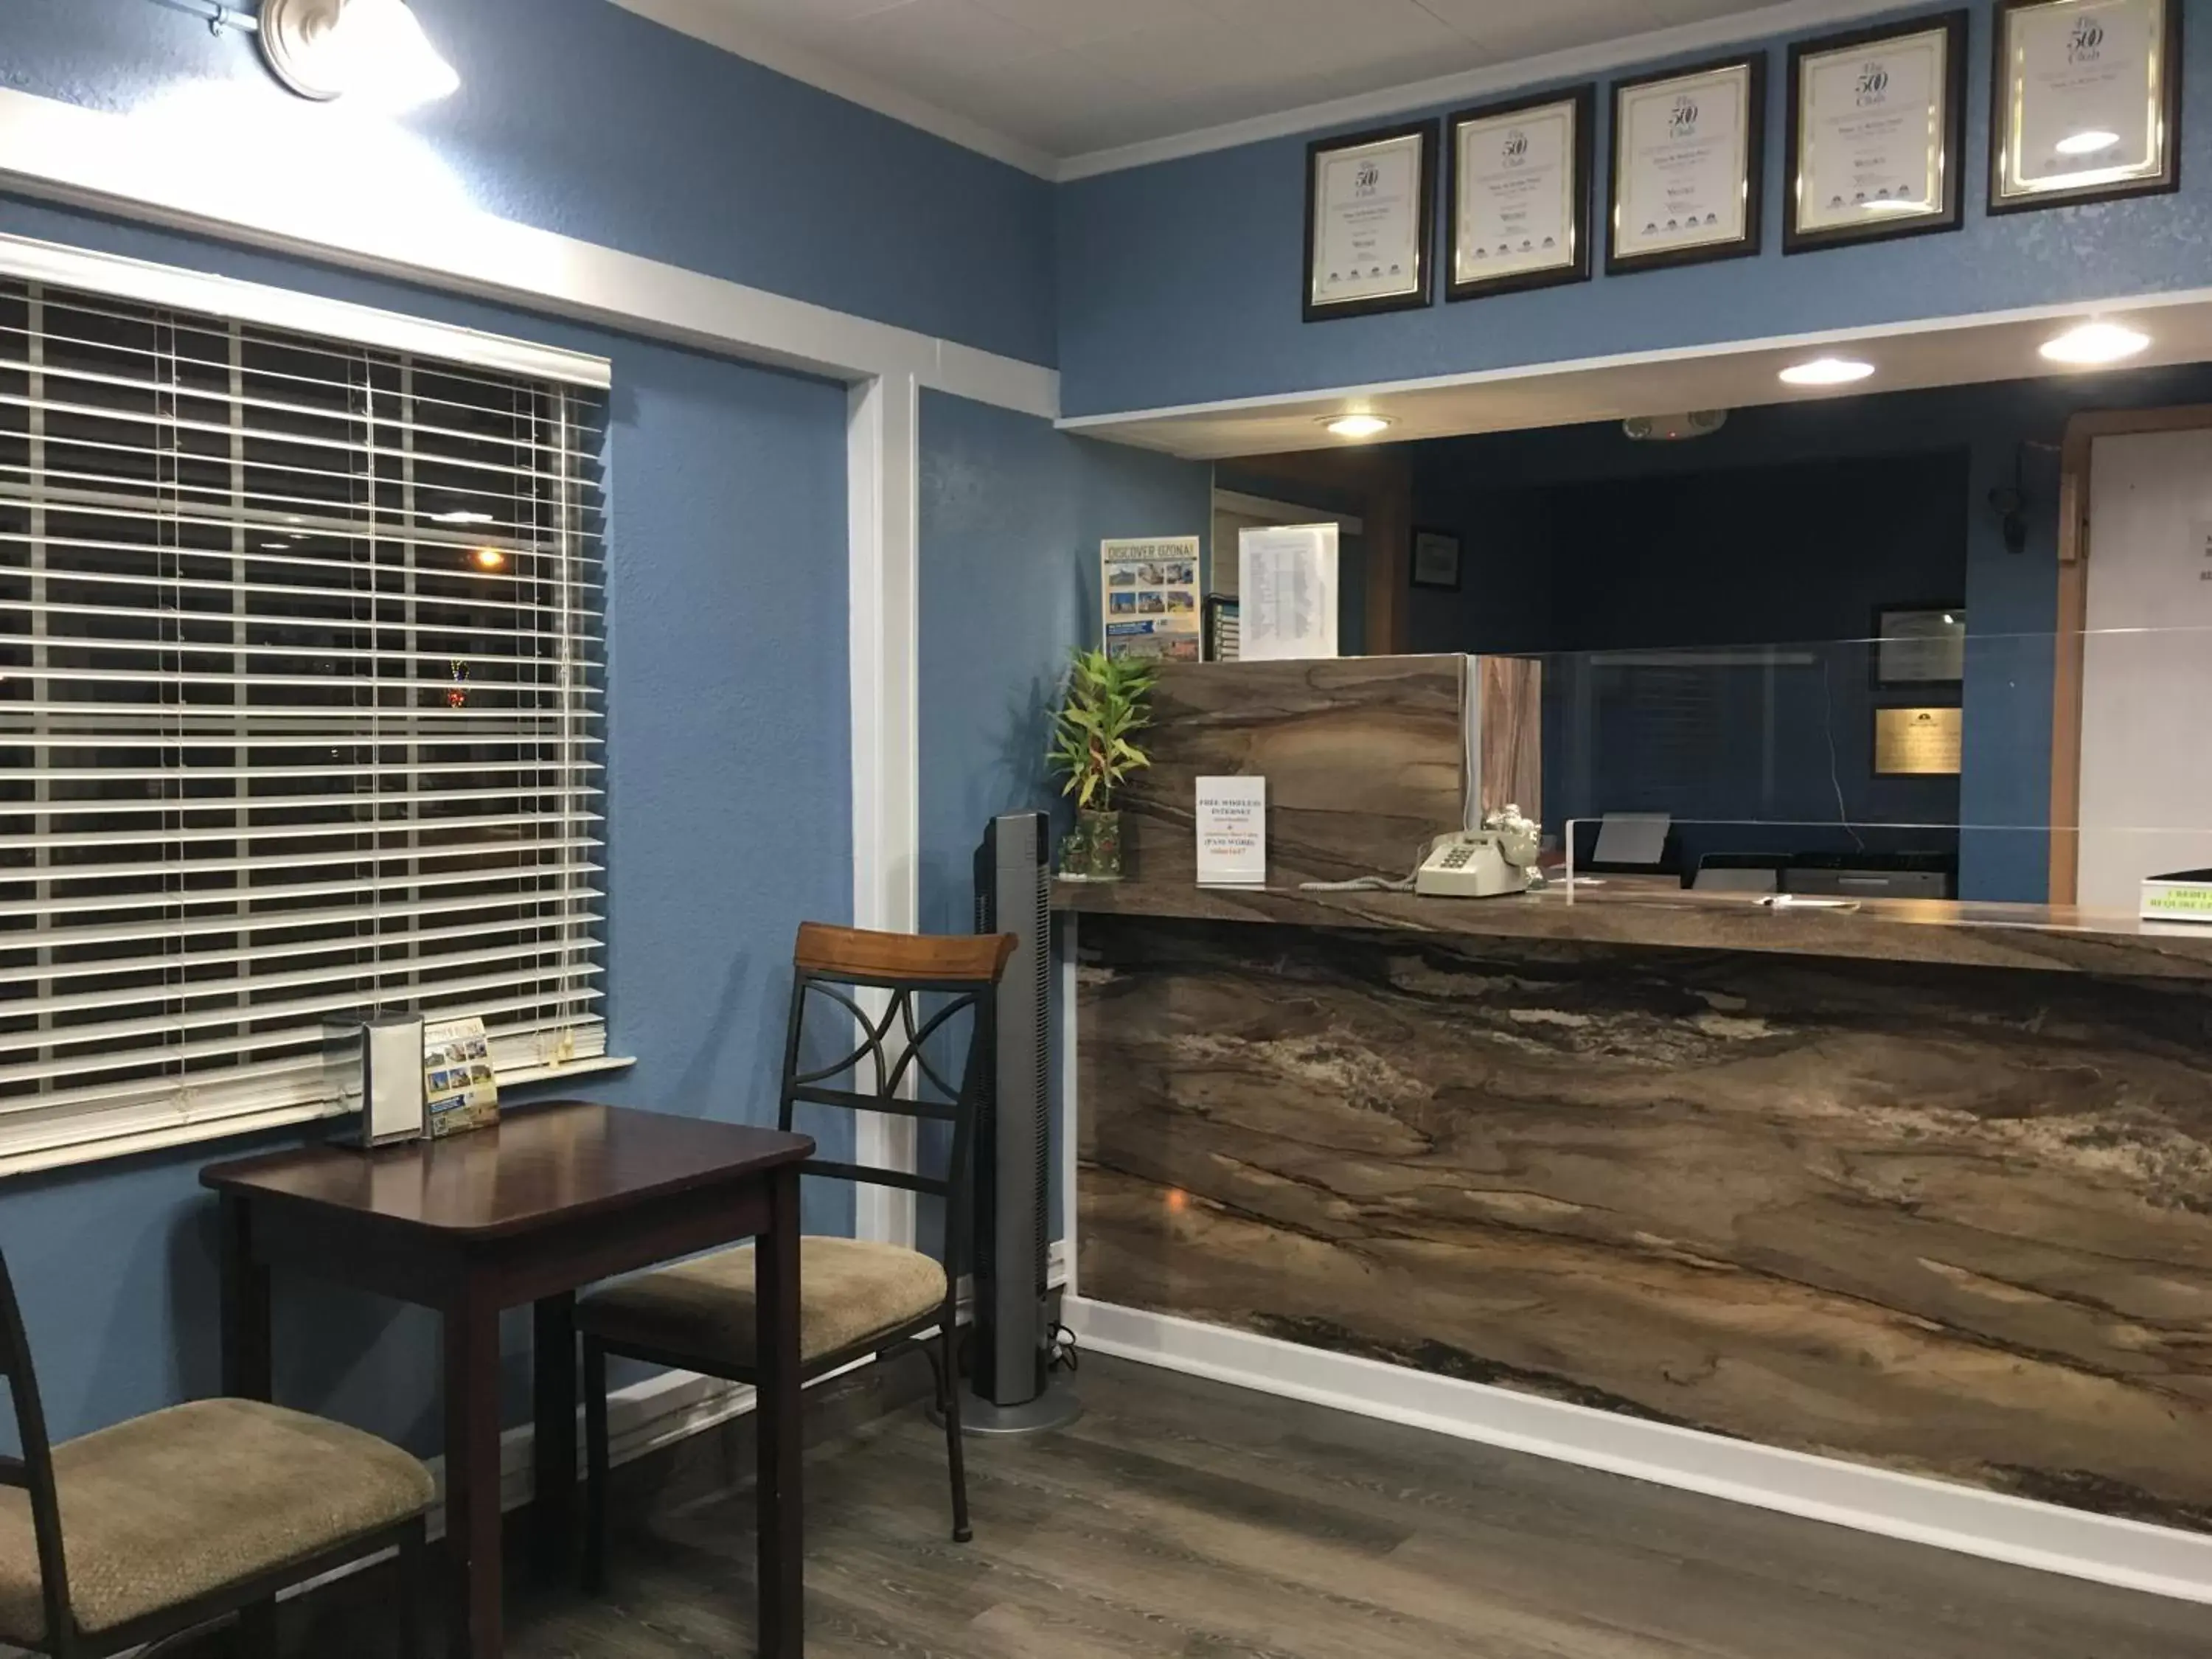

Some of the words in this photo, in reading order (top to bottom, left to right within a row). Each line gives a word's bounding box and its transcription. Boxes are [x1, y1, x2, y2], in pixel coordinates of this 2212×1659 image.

[2066, 27, 2103, 52] 500
[1855, 72, 1888, 93] 500
[1669, 105, 1698, 127] 500
[1502, 137, 1527, 156] 500
[1355, 170, 1378, 187] 500
[1107, 546, 1155, 560] DISCOVER
